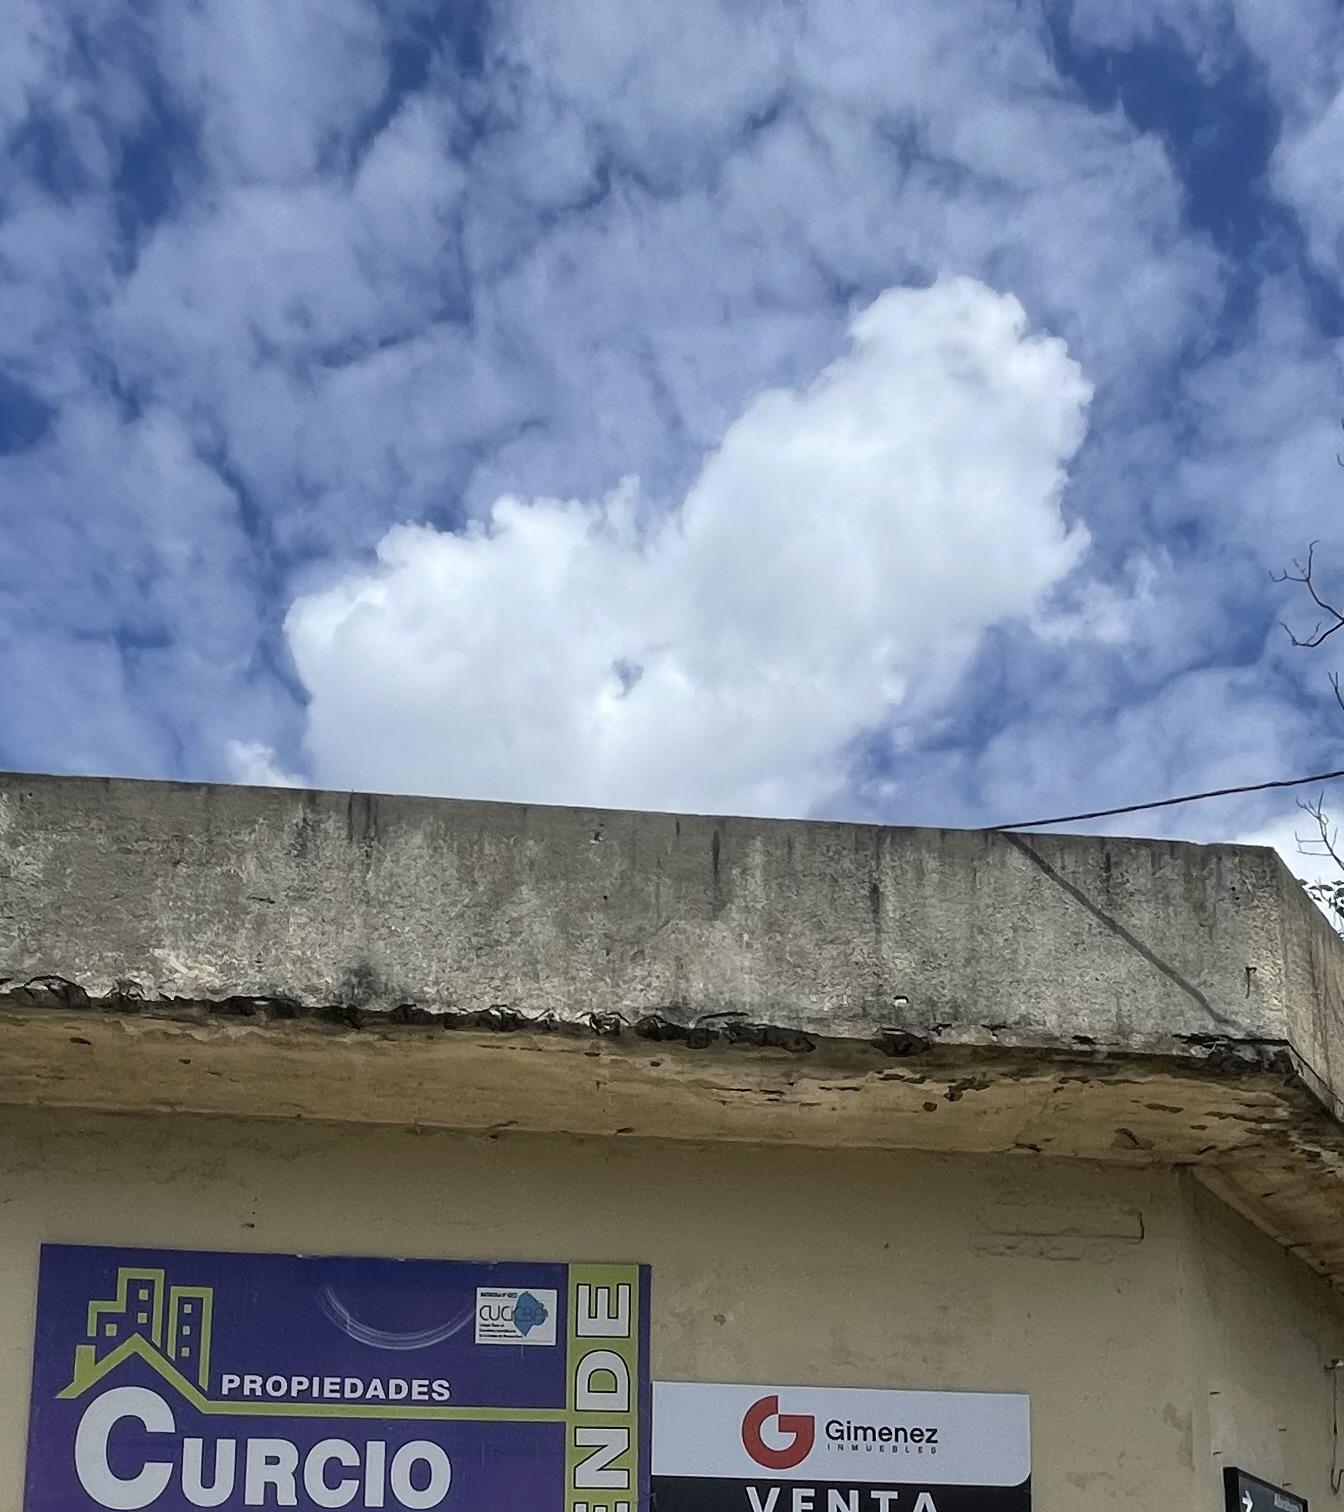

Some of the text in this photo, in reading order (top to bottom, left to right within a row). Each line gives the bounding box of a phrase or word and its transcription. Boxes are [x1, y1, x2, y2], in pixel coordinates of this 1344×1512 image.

[221, 1374, 451, 1401] PROPIEDADES
[825, 1419, 939, 1444] Gimenez
[74, 1386, 453, 1510] CURCIO
[827, 1443, 937, 1455] INMUEBLES
